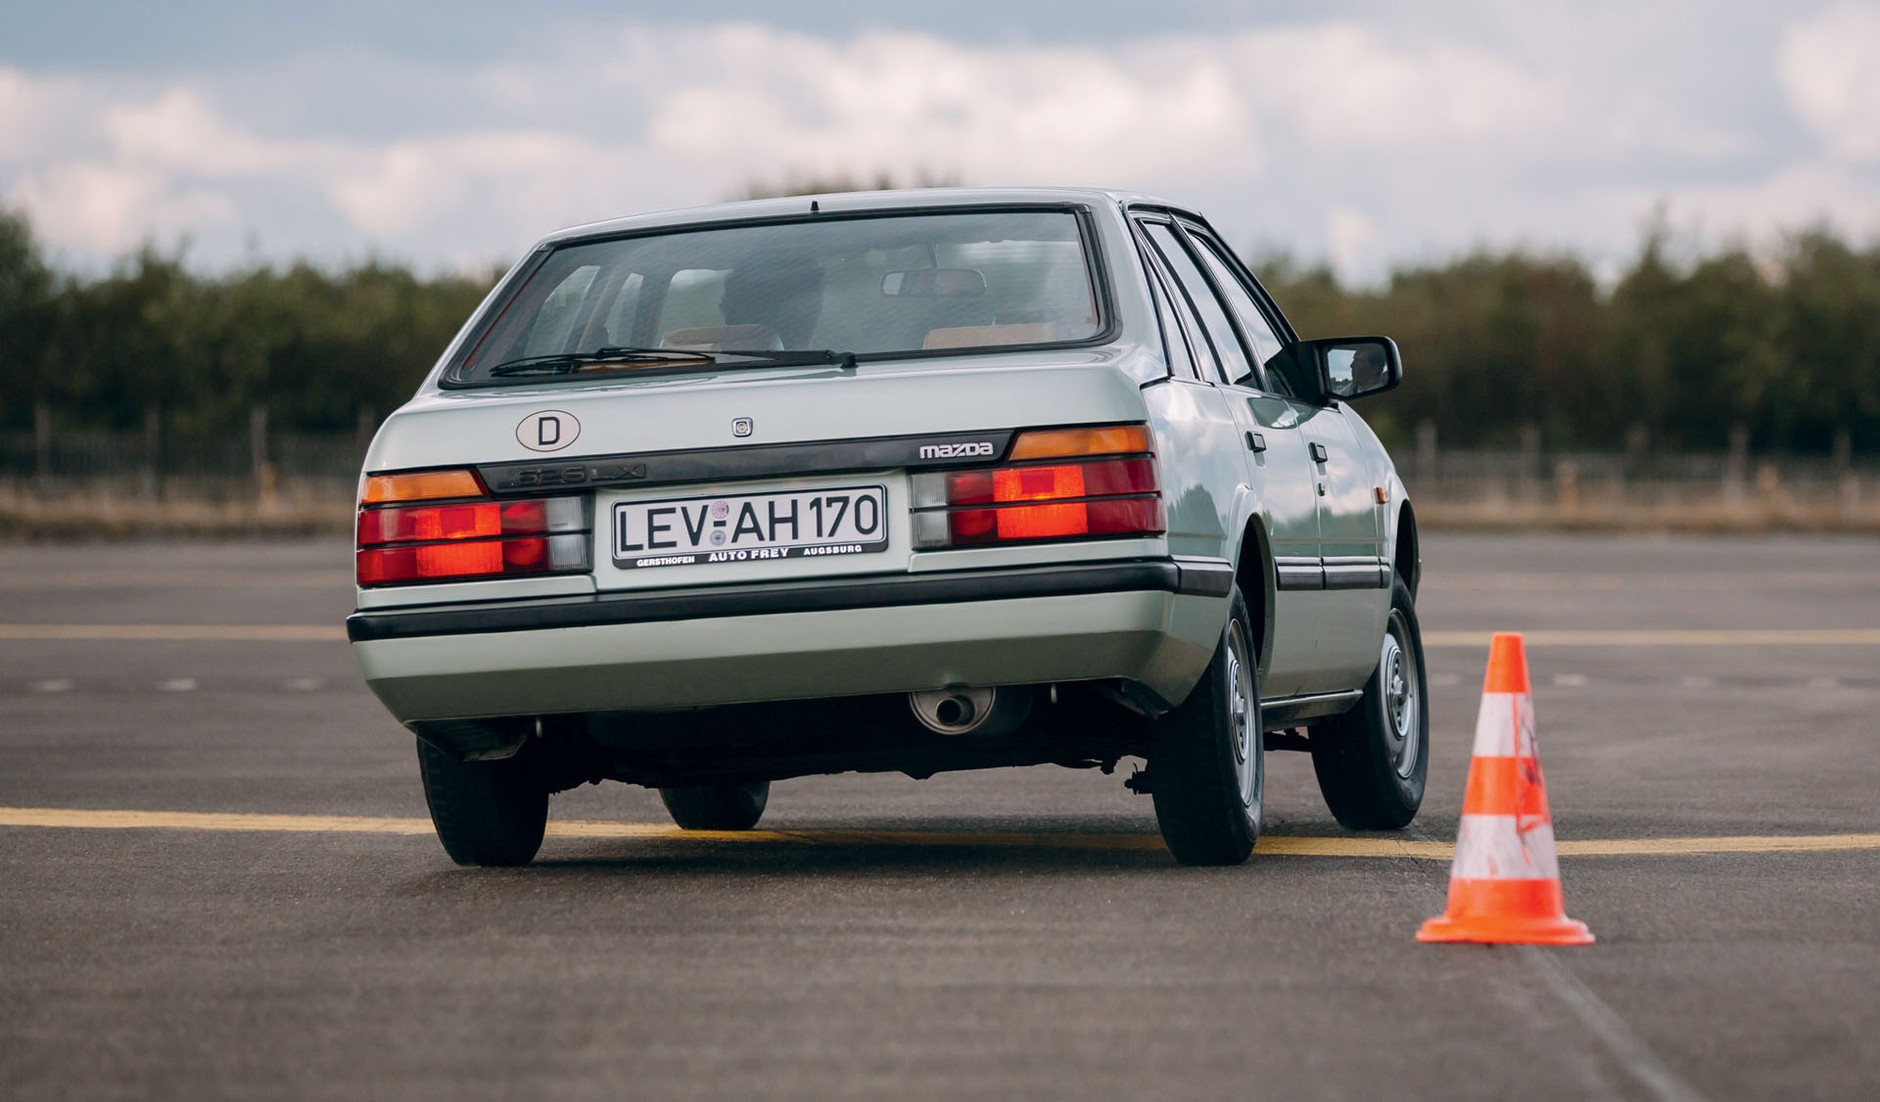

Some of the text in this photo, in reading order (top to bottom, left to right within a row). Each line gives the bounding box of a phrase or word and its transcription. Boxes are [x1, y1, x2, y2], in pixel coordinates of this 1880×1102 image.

[538, 416, 560, 446] D
[636, 544, 862, 567] GERSTHOFEN AUTO FREY AUGSBURG
